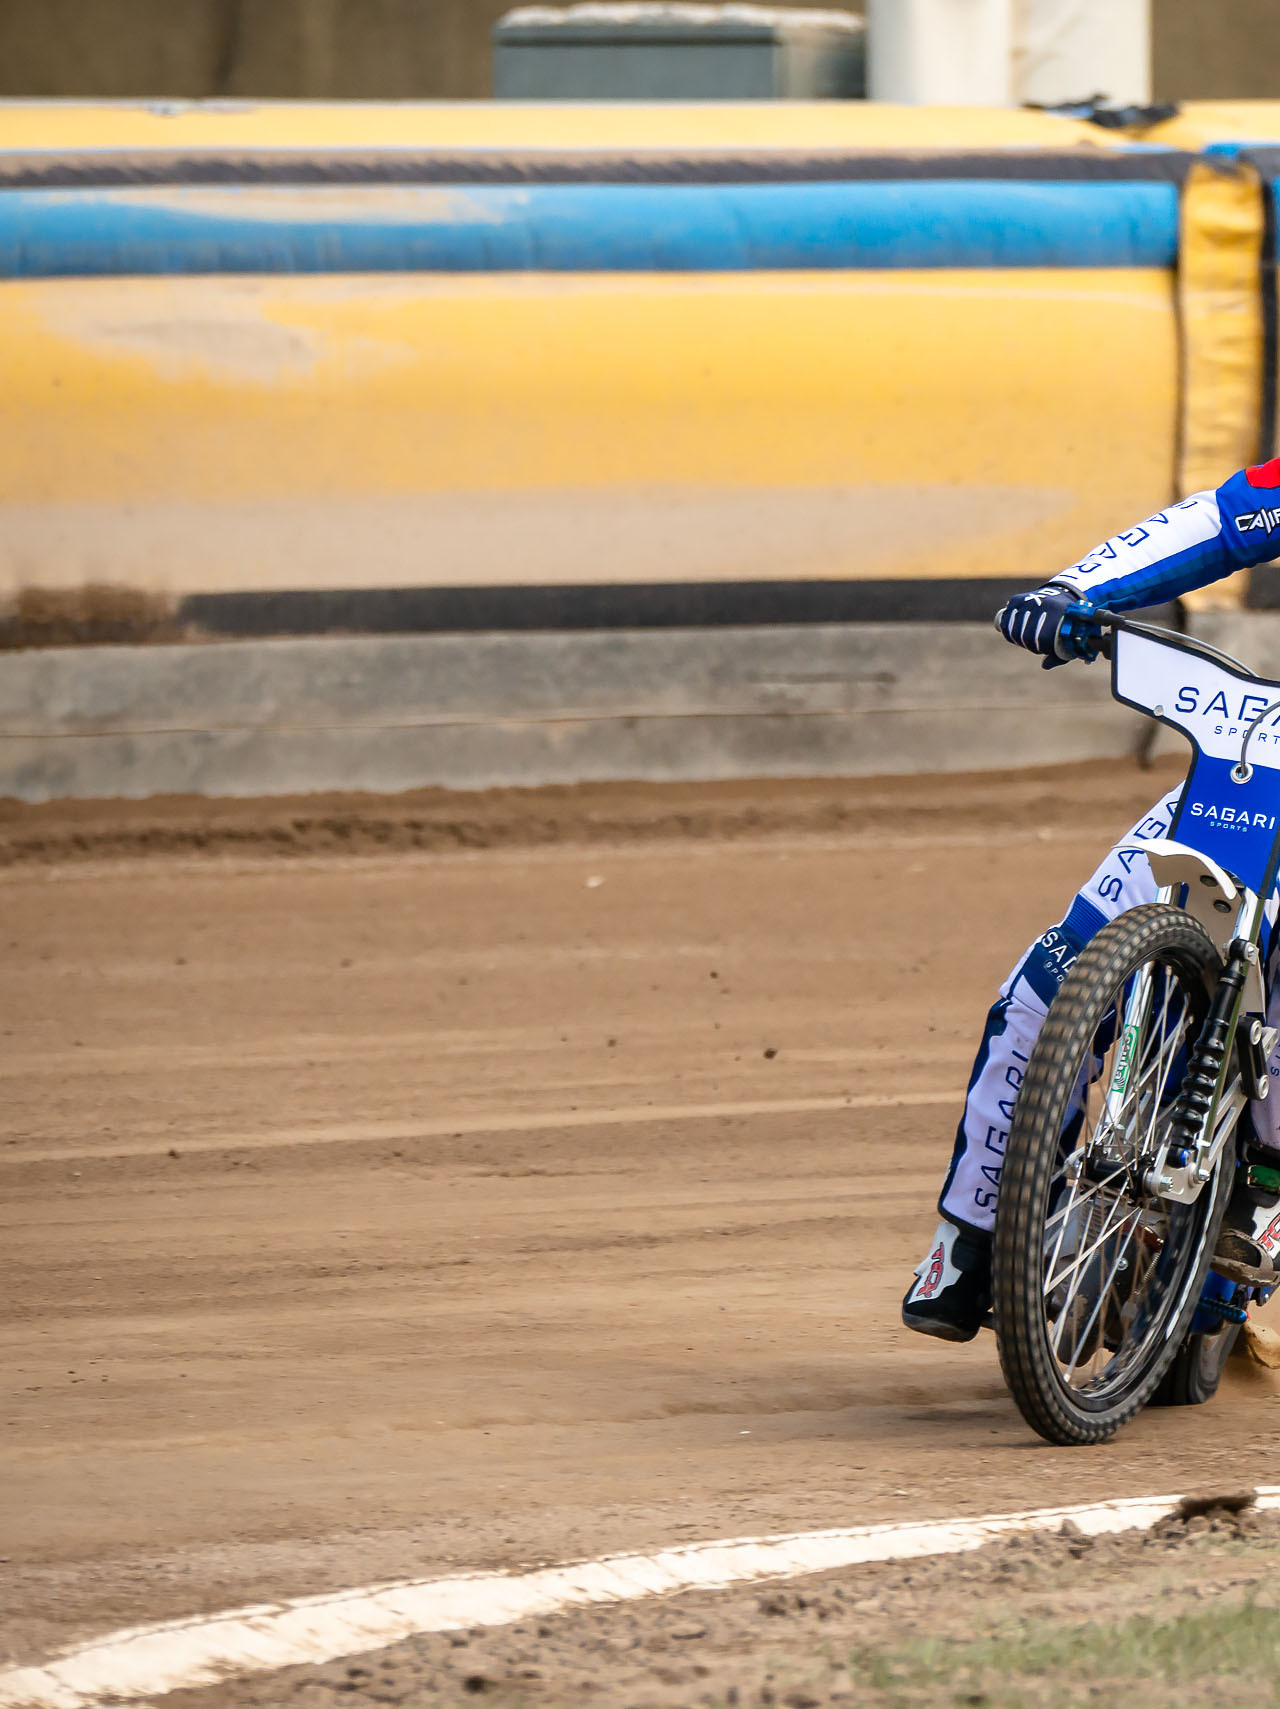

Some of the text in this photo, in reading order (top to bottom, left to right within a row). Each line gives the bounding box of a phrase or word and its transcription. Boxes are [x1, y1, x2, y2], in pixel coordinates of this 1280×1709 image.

[1190, 802, 1276, 830] SAGARI
[1209, 821, 1248, 833] SPORTS
[1097, 799, 1180, 903] SAGA
[915, 1241, 946, 1298] TCX
